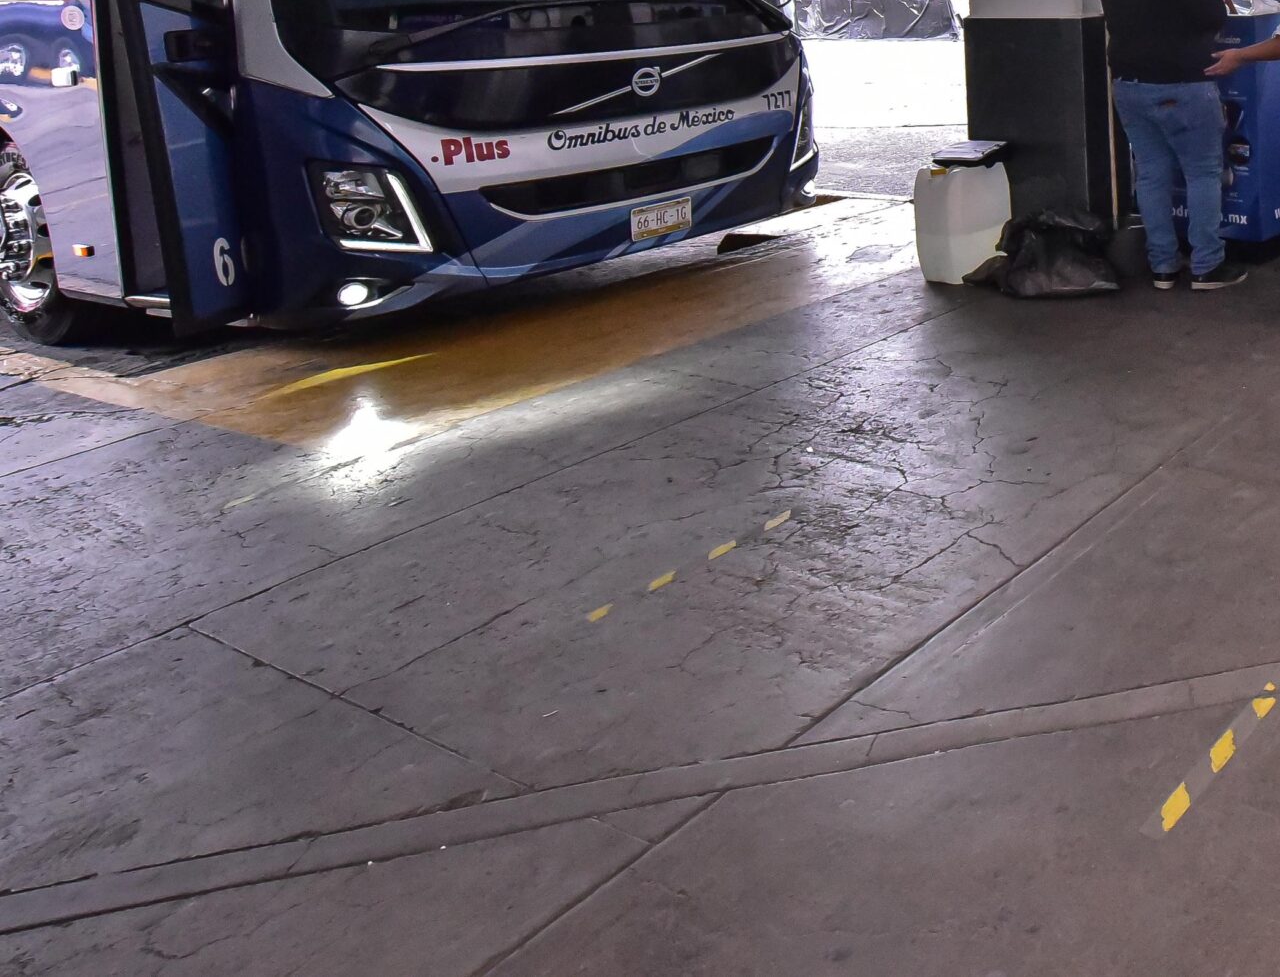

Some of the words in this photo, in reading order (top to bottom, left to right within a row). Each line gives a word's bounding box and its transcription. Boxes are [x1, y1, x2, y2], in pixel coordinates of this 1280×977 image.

[546, 124, 642, 151] Omnibus
[644, 114, 667, 136] de
[669, 108, 736, 132] México
[637, 206, 687, 229] 66-HC-1G
[213, 237, 236, 287] 6
